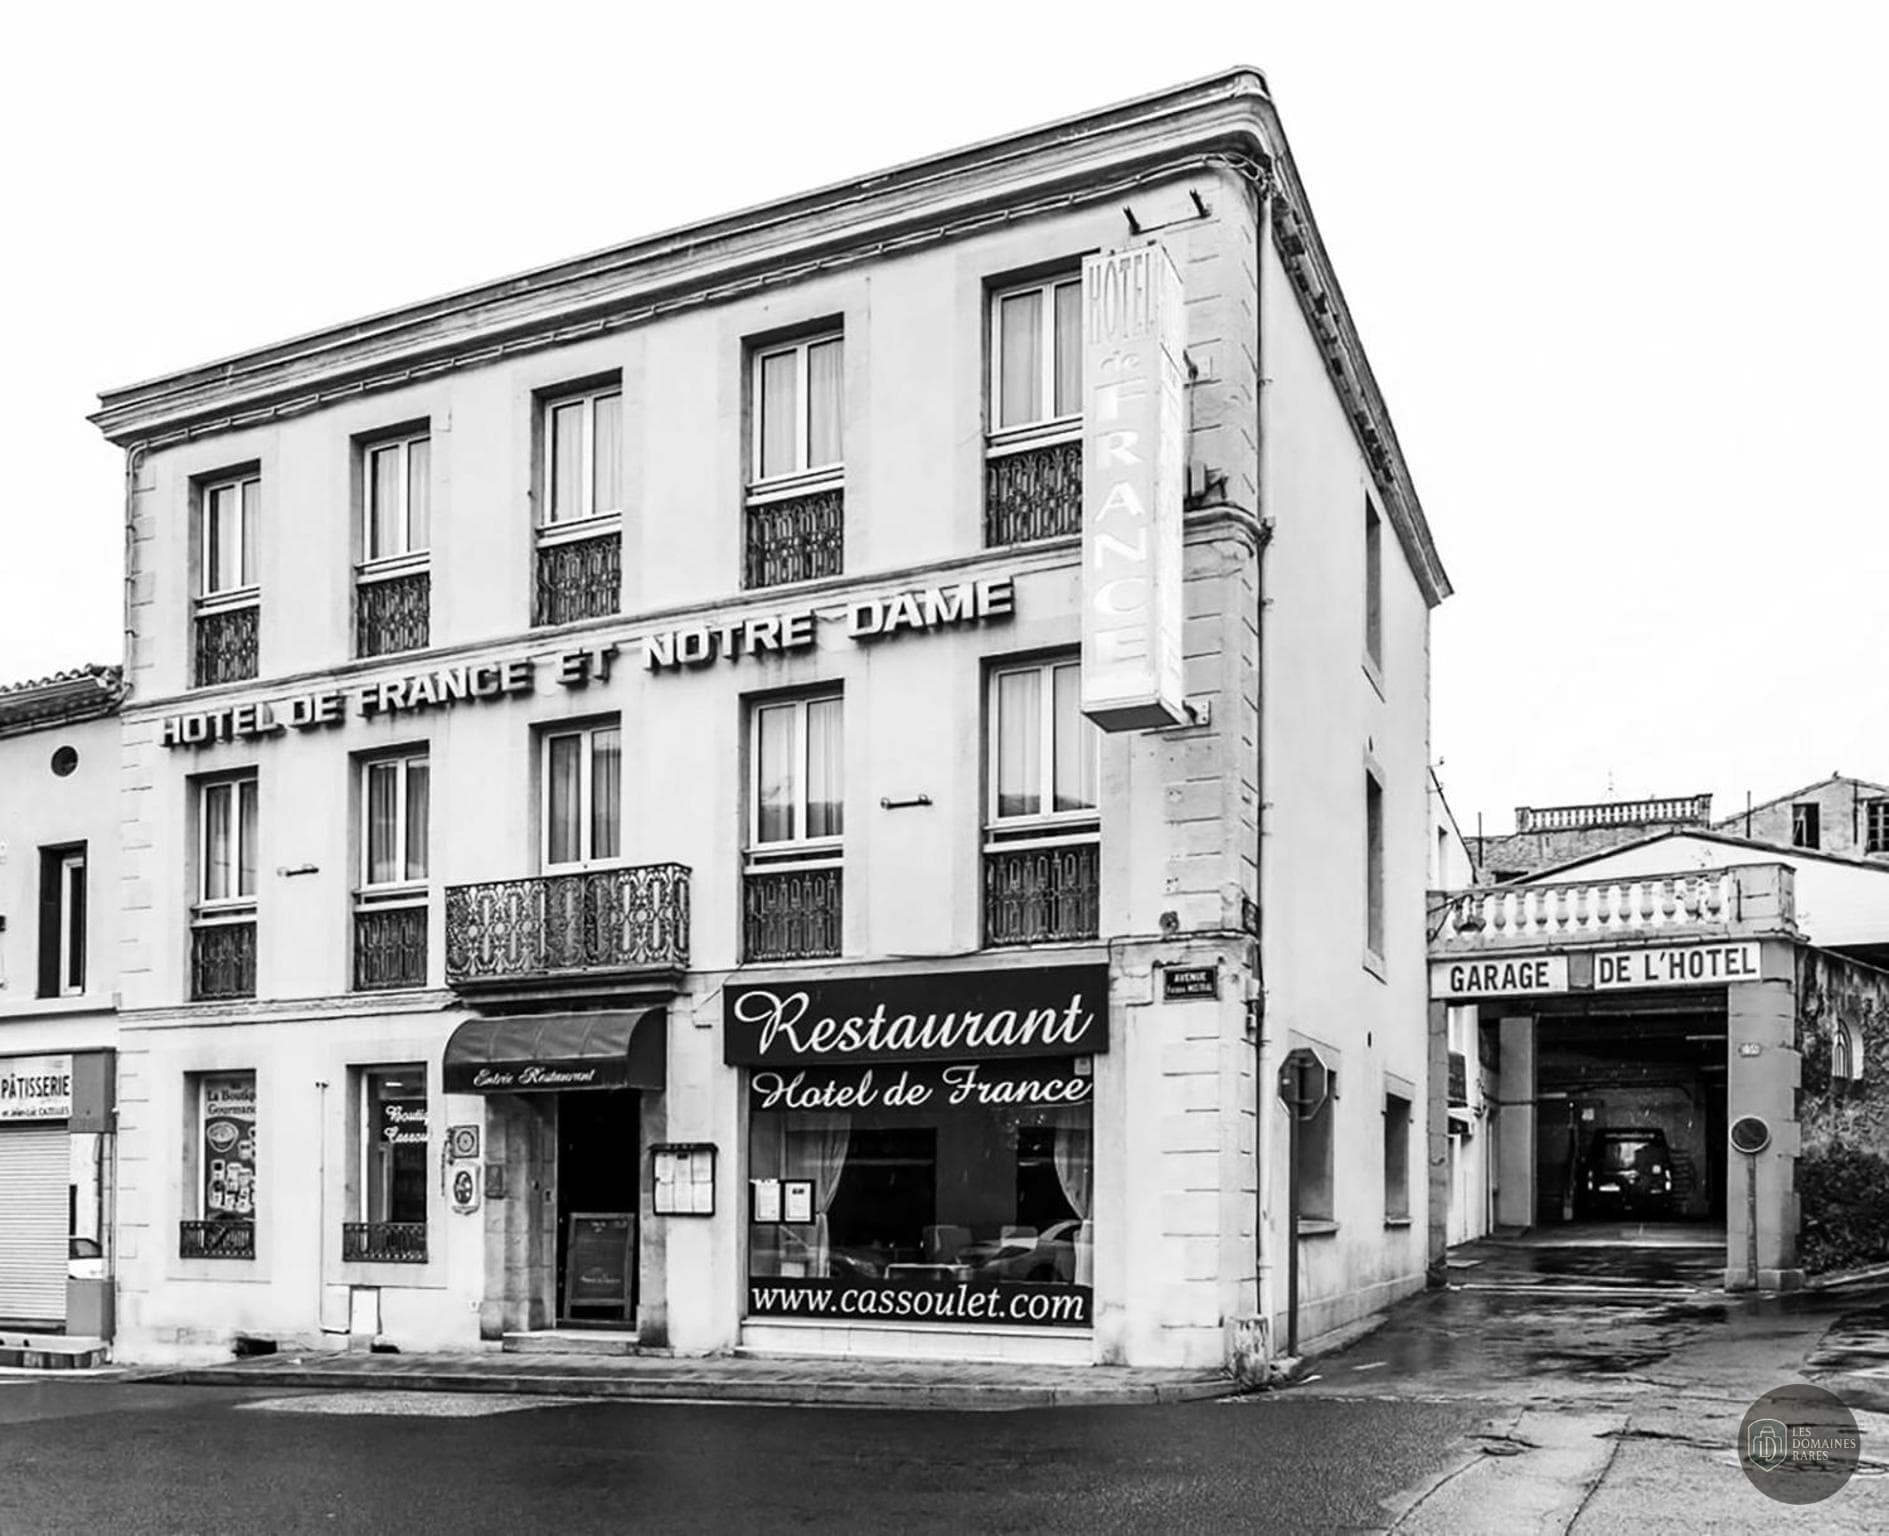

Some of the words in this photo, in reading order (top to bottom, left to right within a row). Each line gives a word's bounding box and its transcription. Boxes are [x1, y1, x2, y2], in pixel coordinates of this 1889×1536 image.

[1093, 376, 1150, 672] FRANCE
[161, 703, 280, 745] HOTEL
[289, 692, 345, 728] DE
[357, 662, 533, 715] FRANCE
[557, 645, 617, 685] ET
[642, 612, 816, 669] NOTRE
[848, 577, 1015, 638] DAME
[1450, 961, 1549, 992] GARAGE
[1600, 956, 1631, 984] DE
[1644, 946, 1757, 981] L'HOTEL
[734, 993, 1094, 1055] Restaurant
[222, 1087, 255, 1102] Boutiq
[752, 1069, 878, 1108] Hotel
[883, 1070, 933, 1106] de
[942, 1064, 1093, 1105] France
[751, 1284, 1085, 1321] www.cassoulet.com
